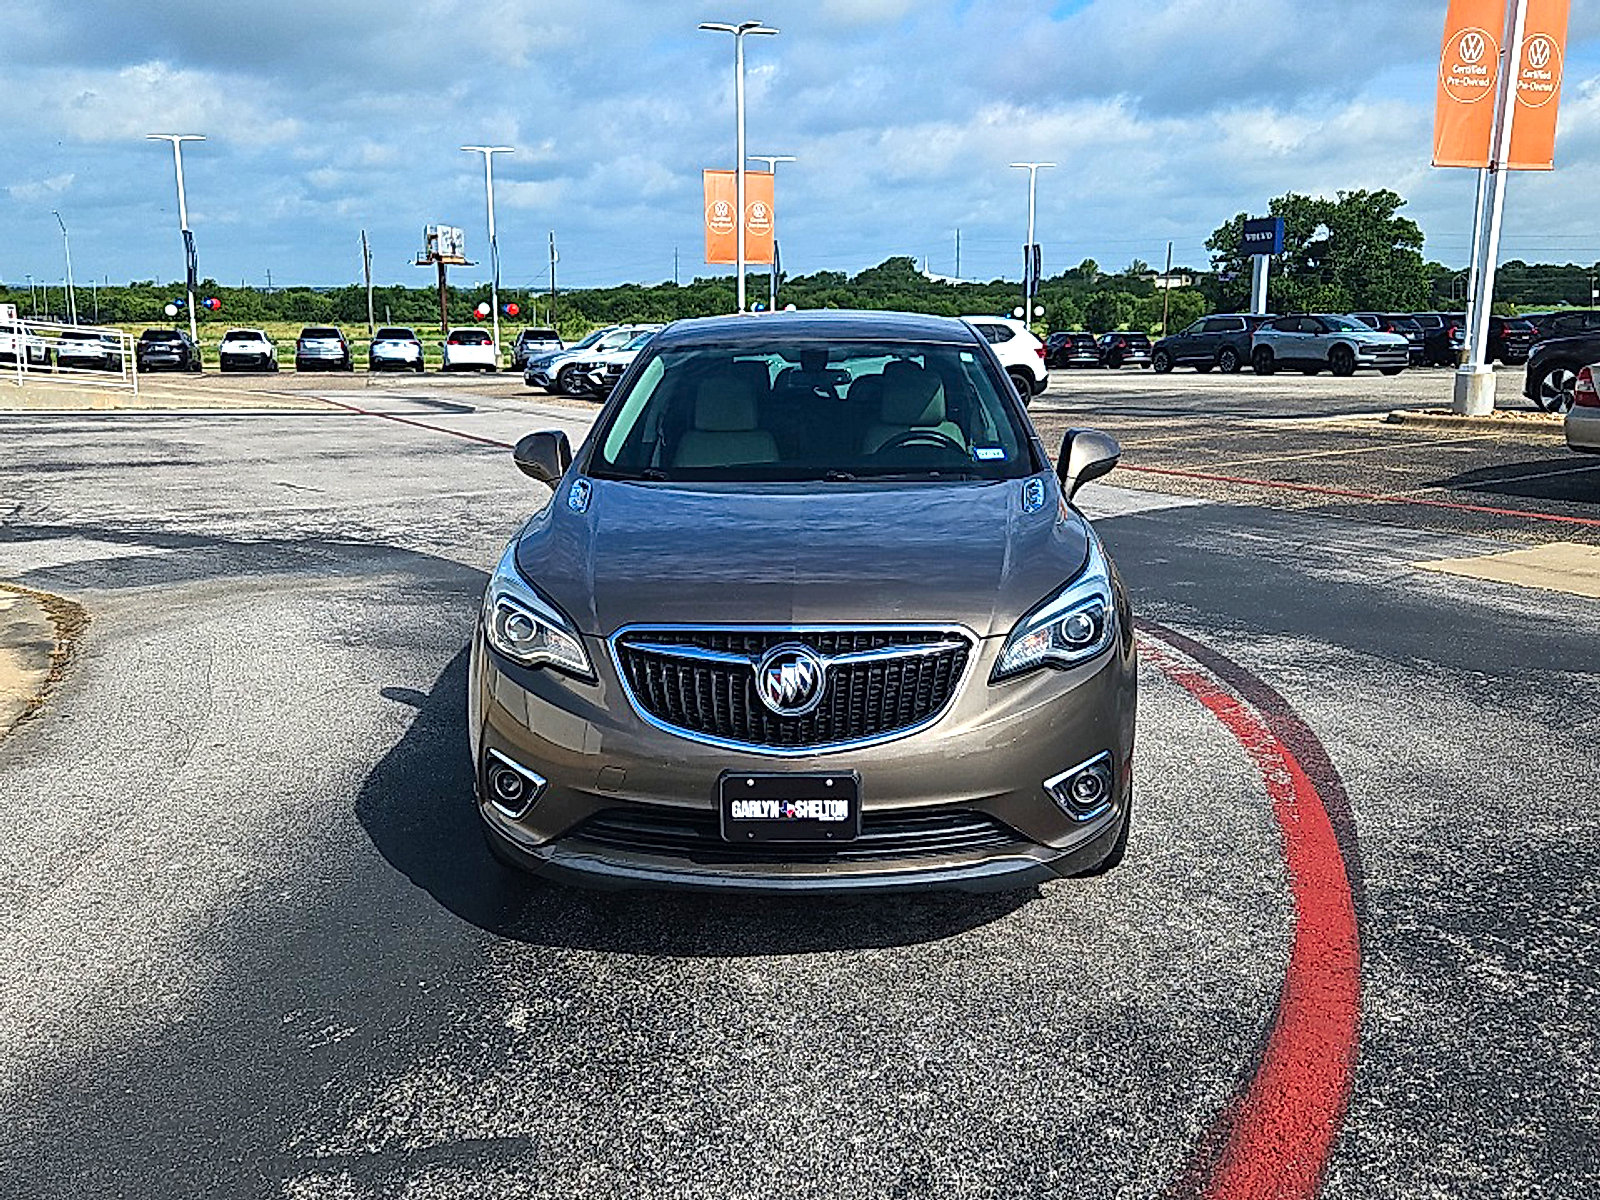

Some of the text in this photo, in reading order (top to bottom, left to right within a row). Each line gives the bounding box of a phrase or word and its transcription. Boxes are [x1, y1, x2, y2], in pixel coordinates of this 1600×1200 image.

[1452, 64, 1487, 75] Certified
[1447, 76, 1490, 87] Pre-Owned
[731, 800, 849, 818] GARLYN SHELTON
